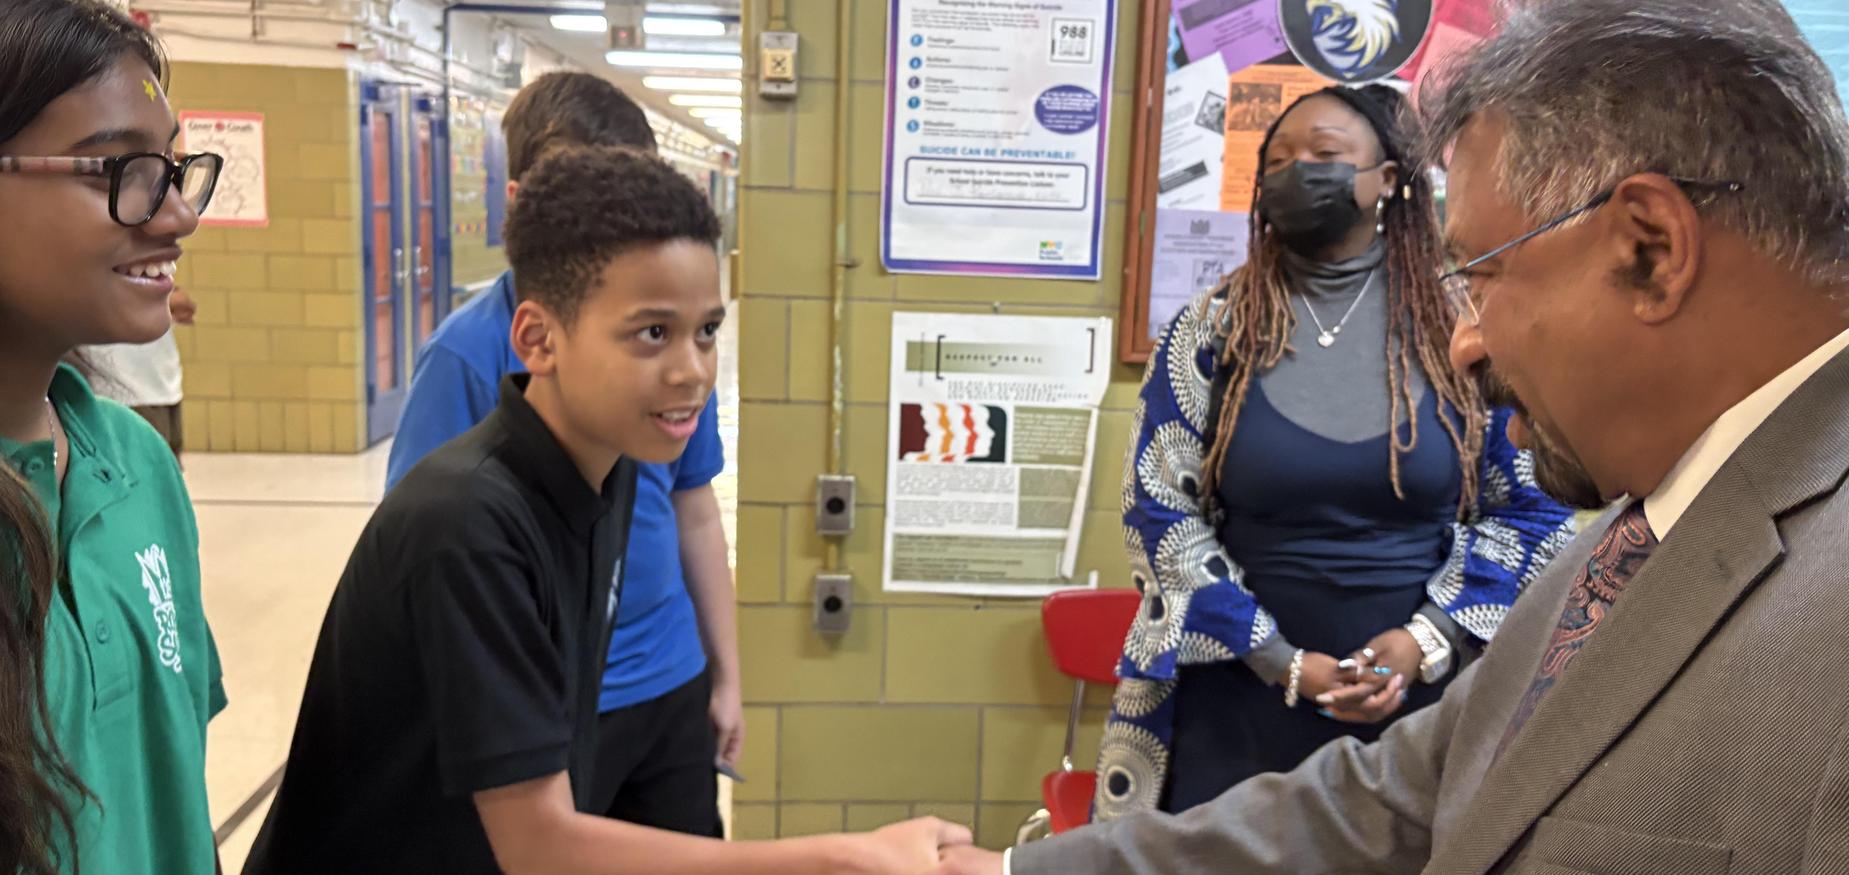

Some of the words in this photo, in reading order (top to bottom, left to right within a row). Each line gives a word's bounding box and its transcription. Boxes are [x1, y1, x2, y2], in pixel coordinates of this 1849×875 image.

[1060, 25, 1087, 39] 988
[188, 121, 213, 130] Cover
[226, 122, 253, 133] Cough
[920, 146, 958, 156] SUICIDE
[961, 147, 981, 157] CAN
[984, 148, 997, 157] BE
[1000, 149, 1076, 160] PREVENTABLE!
[963, 168, 977, 177] help
[1003, 171, 1031, 179] concerns,
[949, 177, 970, 185] School
[972, 178, 993, 186] Suicide
[1203, 260, 1224, 274] PTA
[945, 353, 992, 362] RESPECT
[997, 354, 1017, 363] FOR
[1023, 356, 1043, 364] ALL
